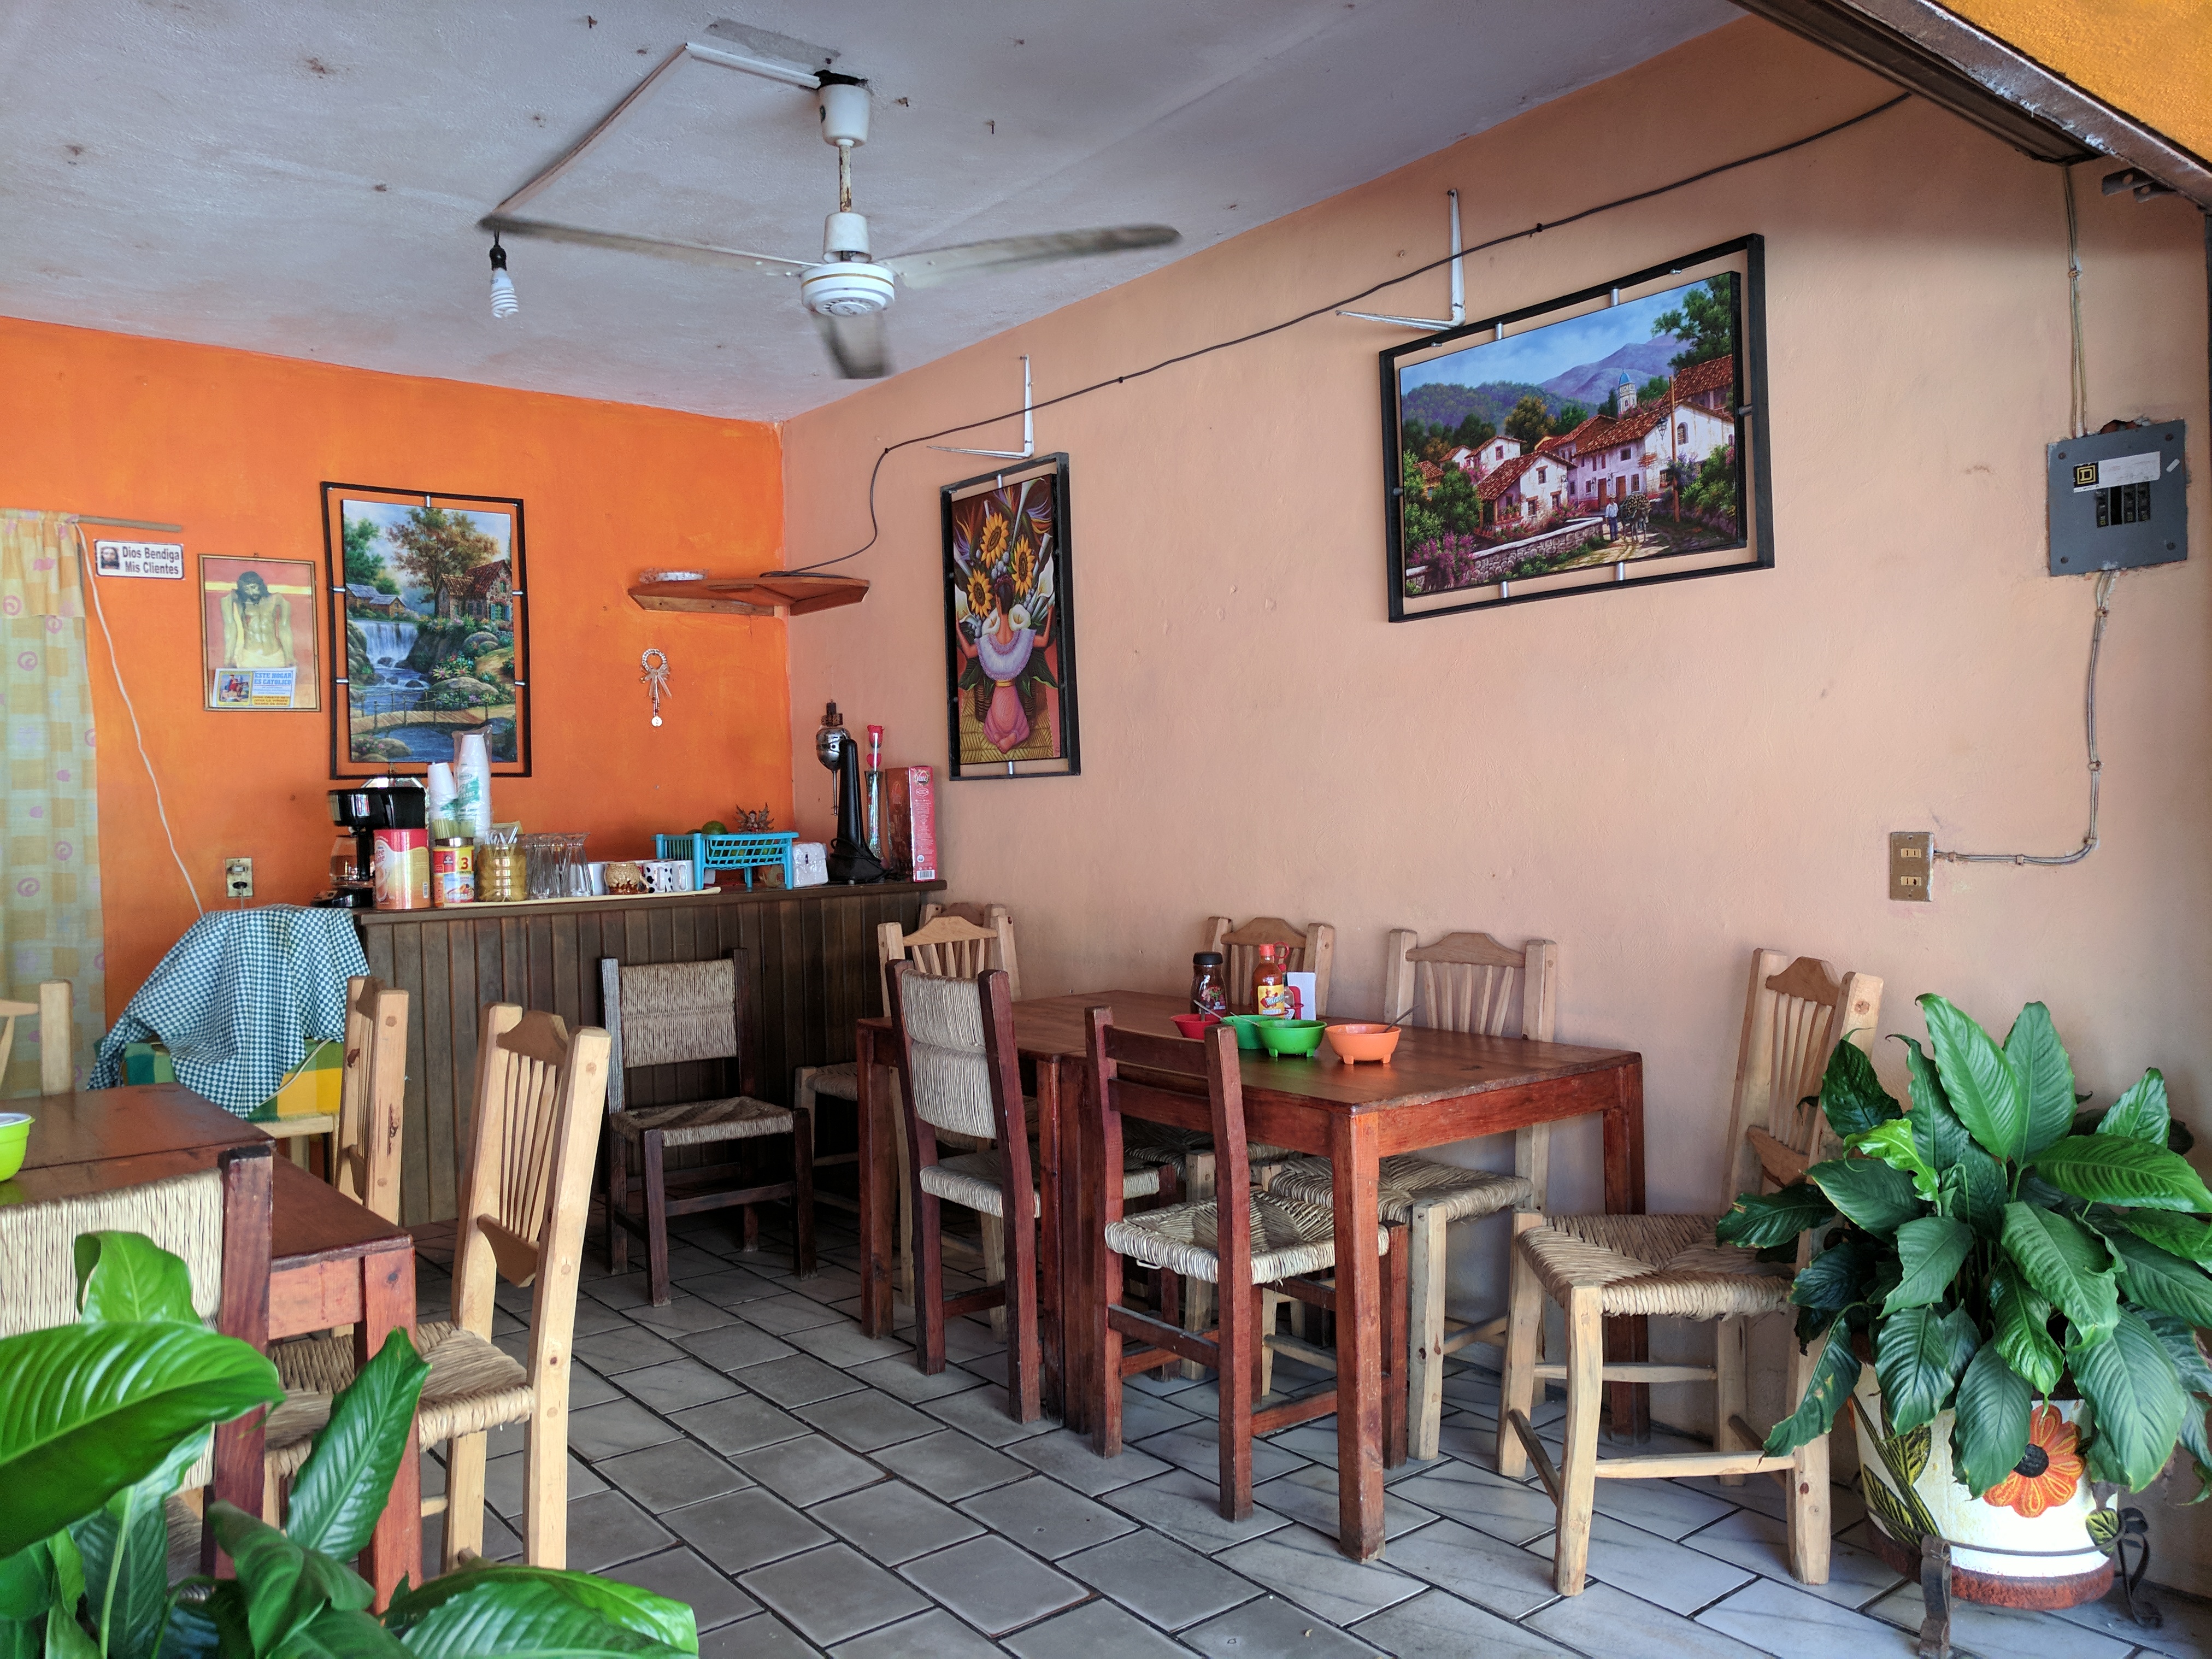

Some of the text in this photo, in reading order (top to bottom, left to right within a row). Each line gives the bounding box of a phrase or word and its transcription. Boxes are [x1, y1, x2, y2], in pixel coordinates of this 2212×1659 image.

[122, 546, 180, 563] Dios Bendiga
[125, 561, 179, 574] Mis Clientes
[461, 857, 468, 870] 3
